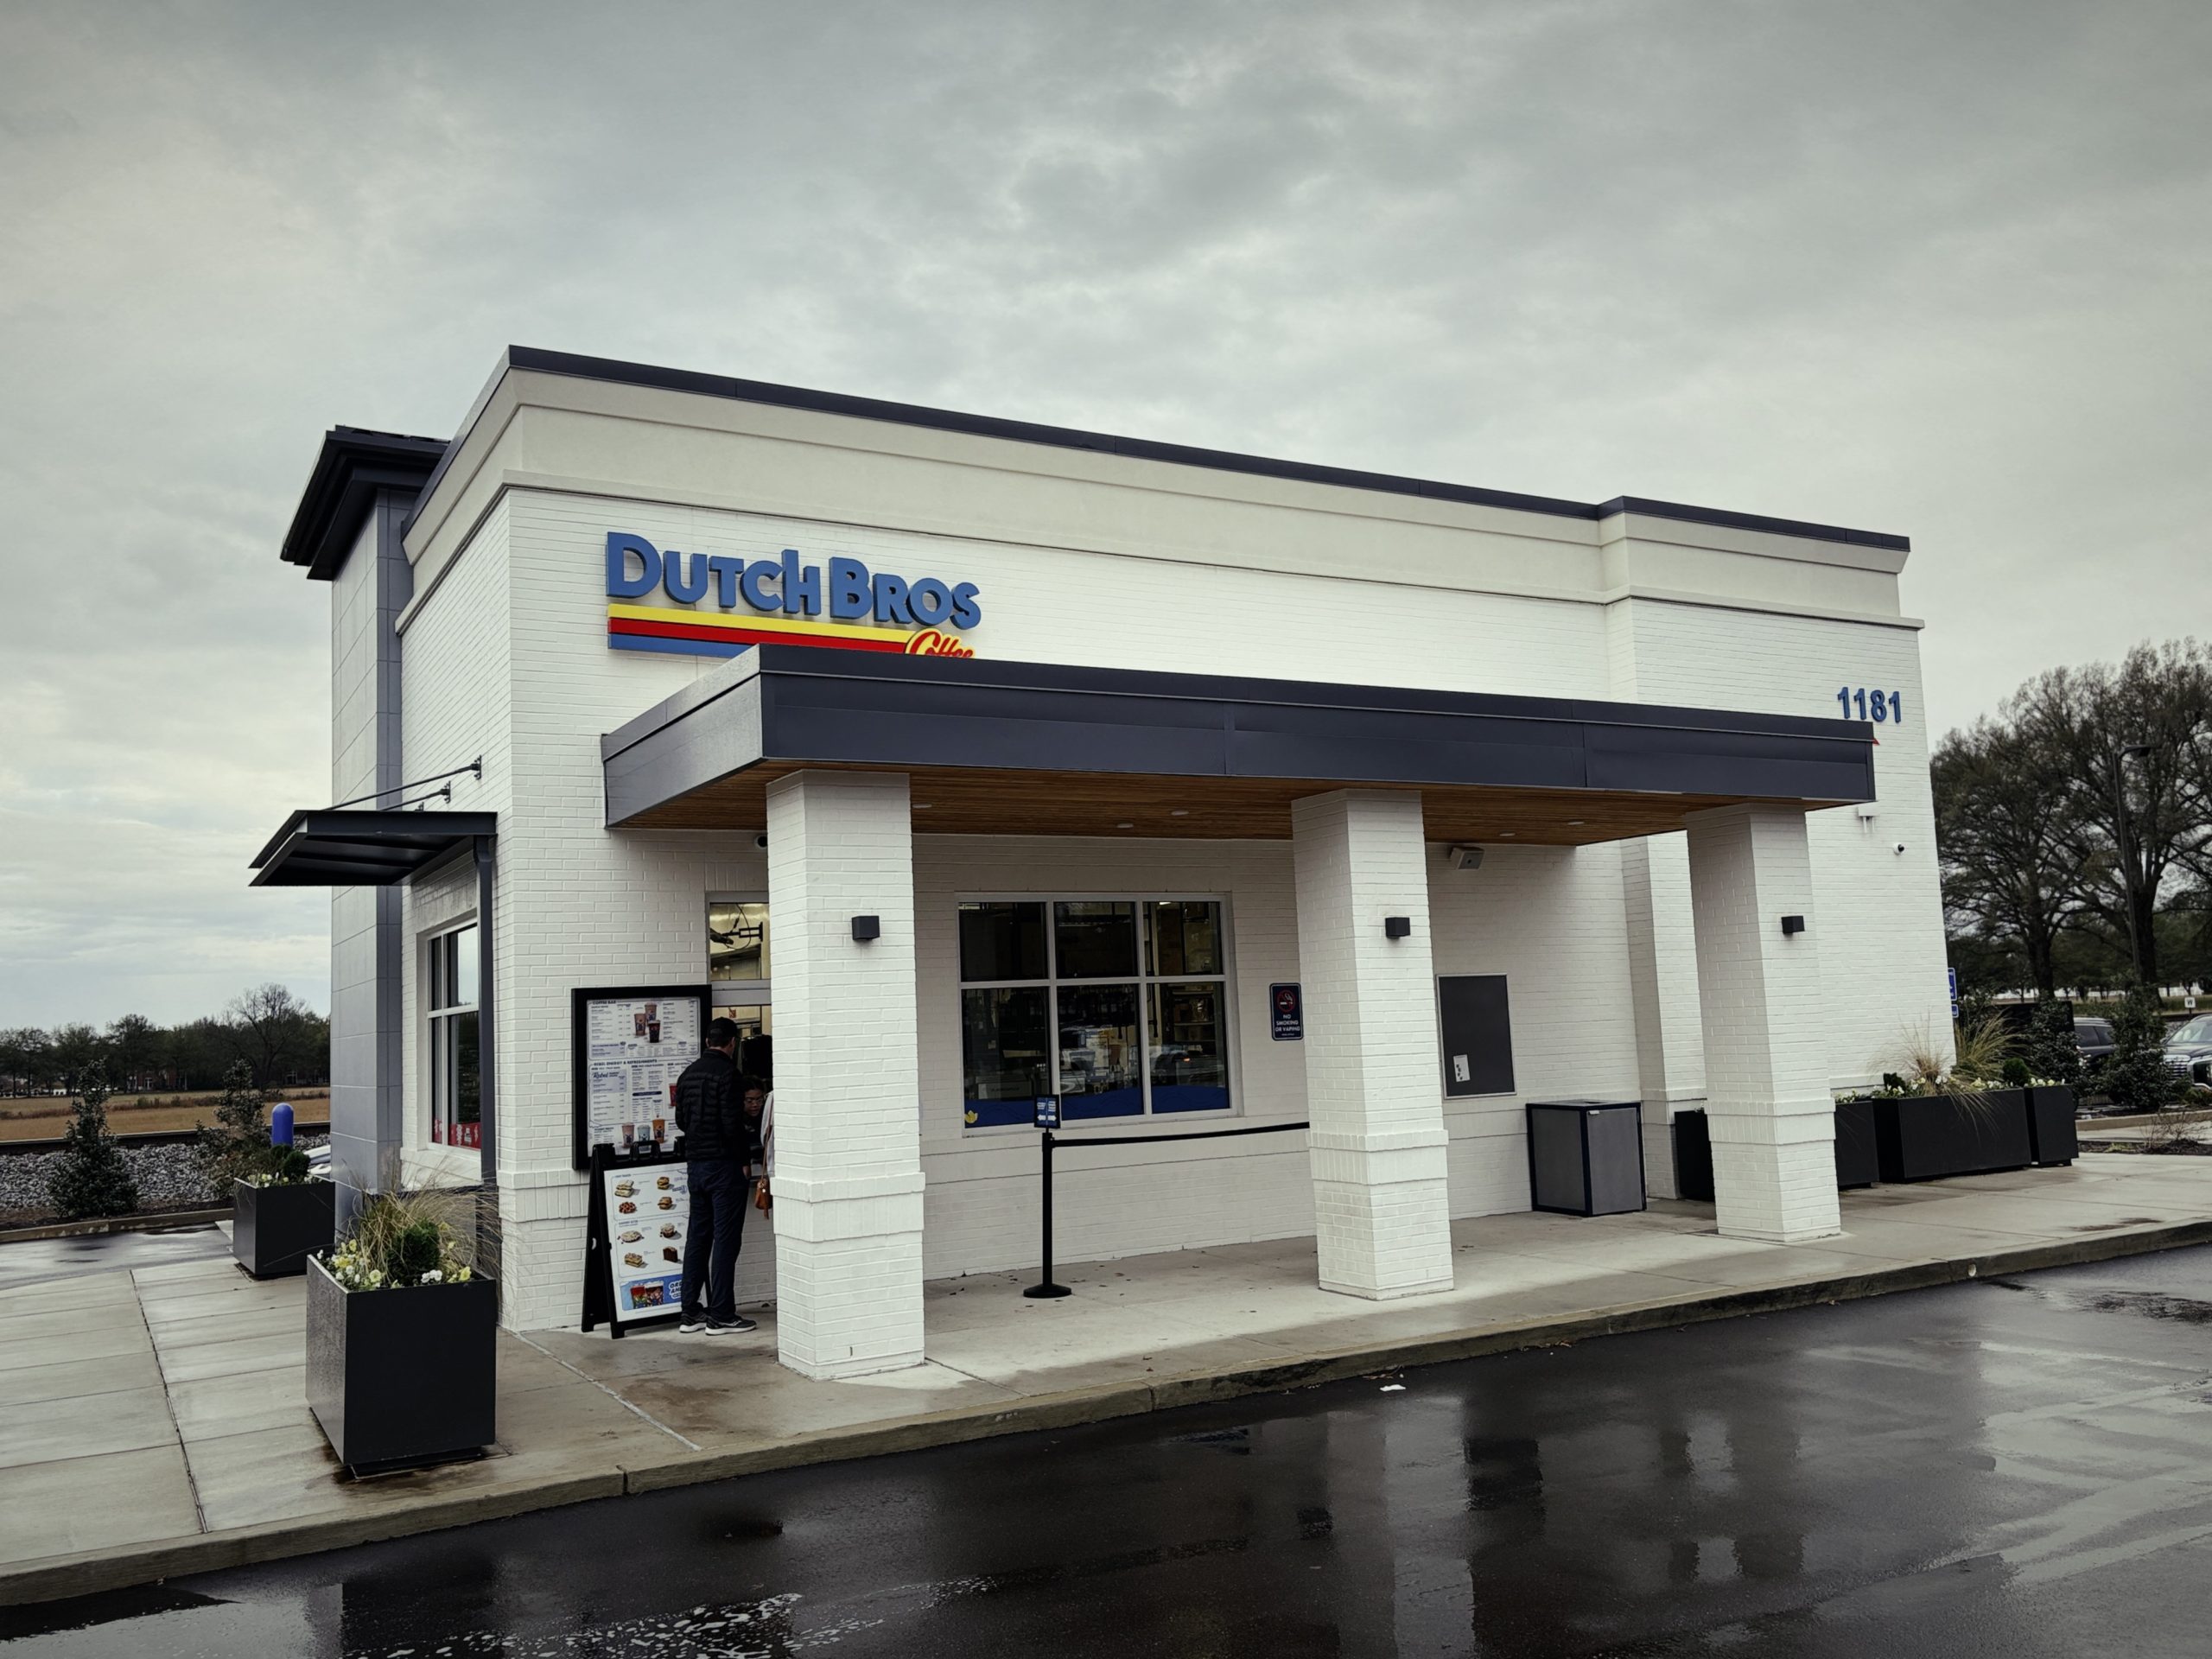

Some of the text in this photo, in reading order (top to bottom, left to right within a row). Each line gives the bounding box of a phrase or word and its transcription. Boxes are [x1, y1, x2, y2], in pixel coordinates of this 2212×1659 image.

[606, 531, 982, 630] DUTCH BROS
[1837, 686, 1902, 724] 1181
